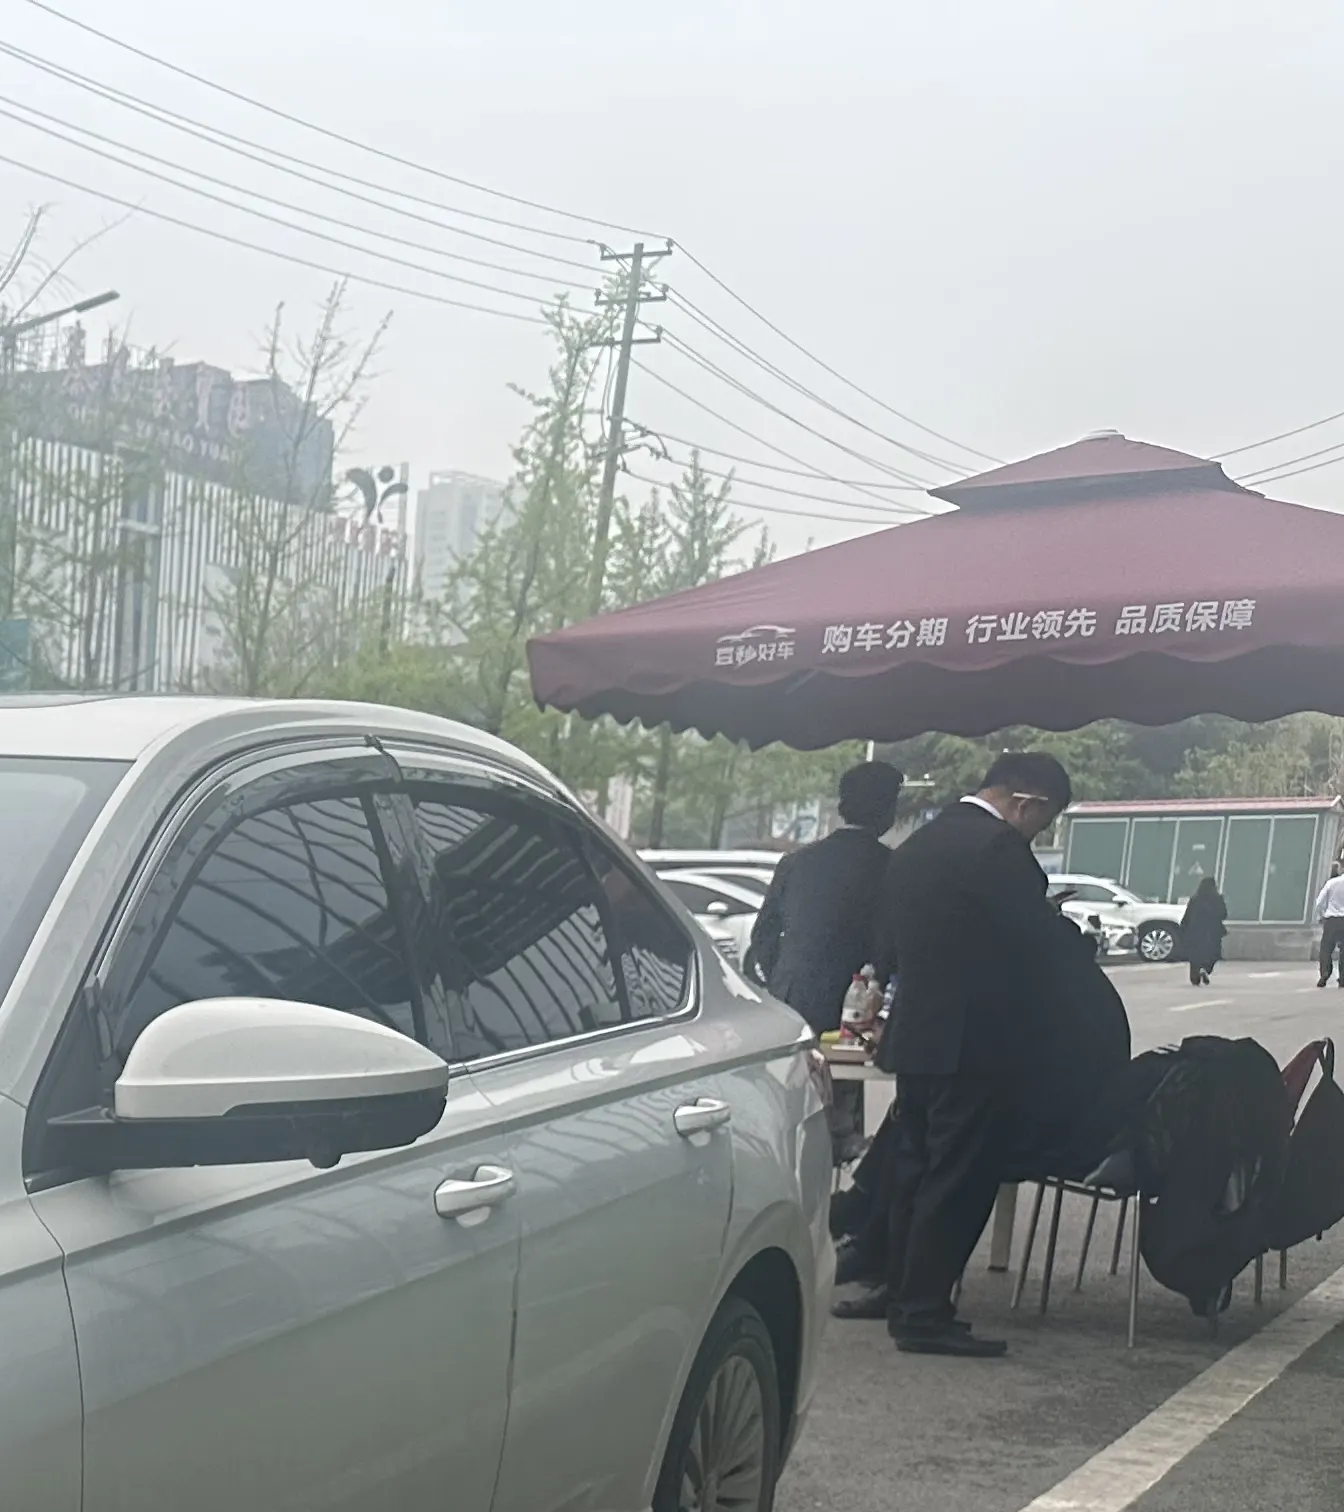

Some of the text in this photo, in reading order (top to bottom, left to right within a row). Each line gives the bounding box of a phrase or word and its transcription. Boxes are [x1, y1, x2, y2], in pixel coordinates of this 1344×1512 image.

[821, 598, 1257, 654] 购车分期 行业领先 品质保障
